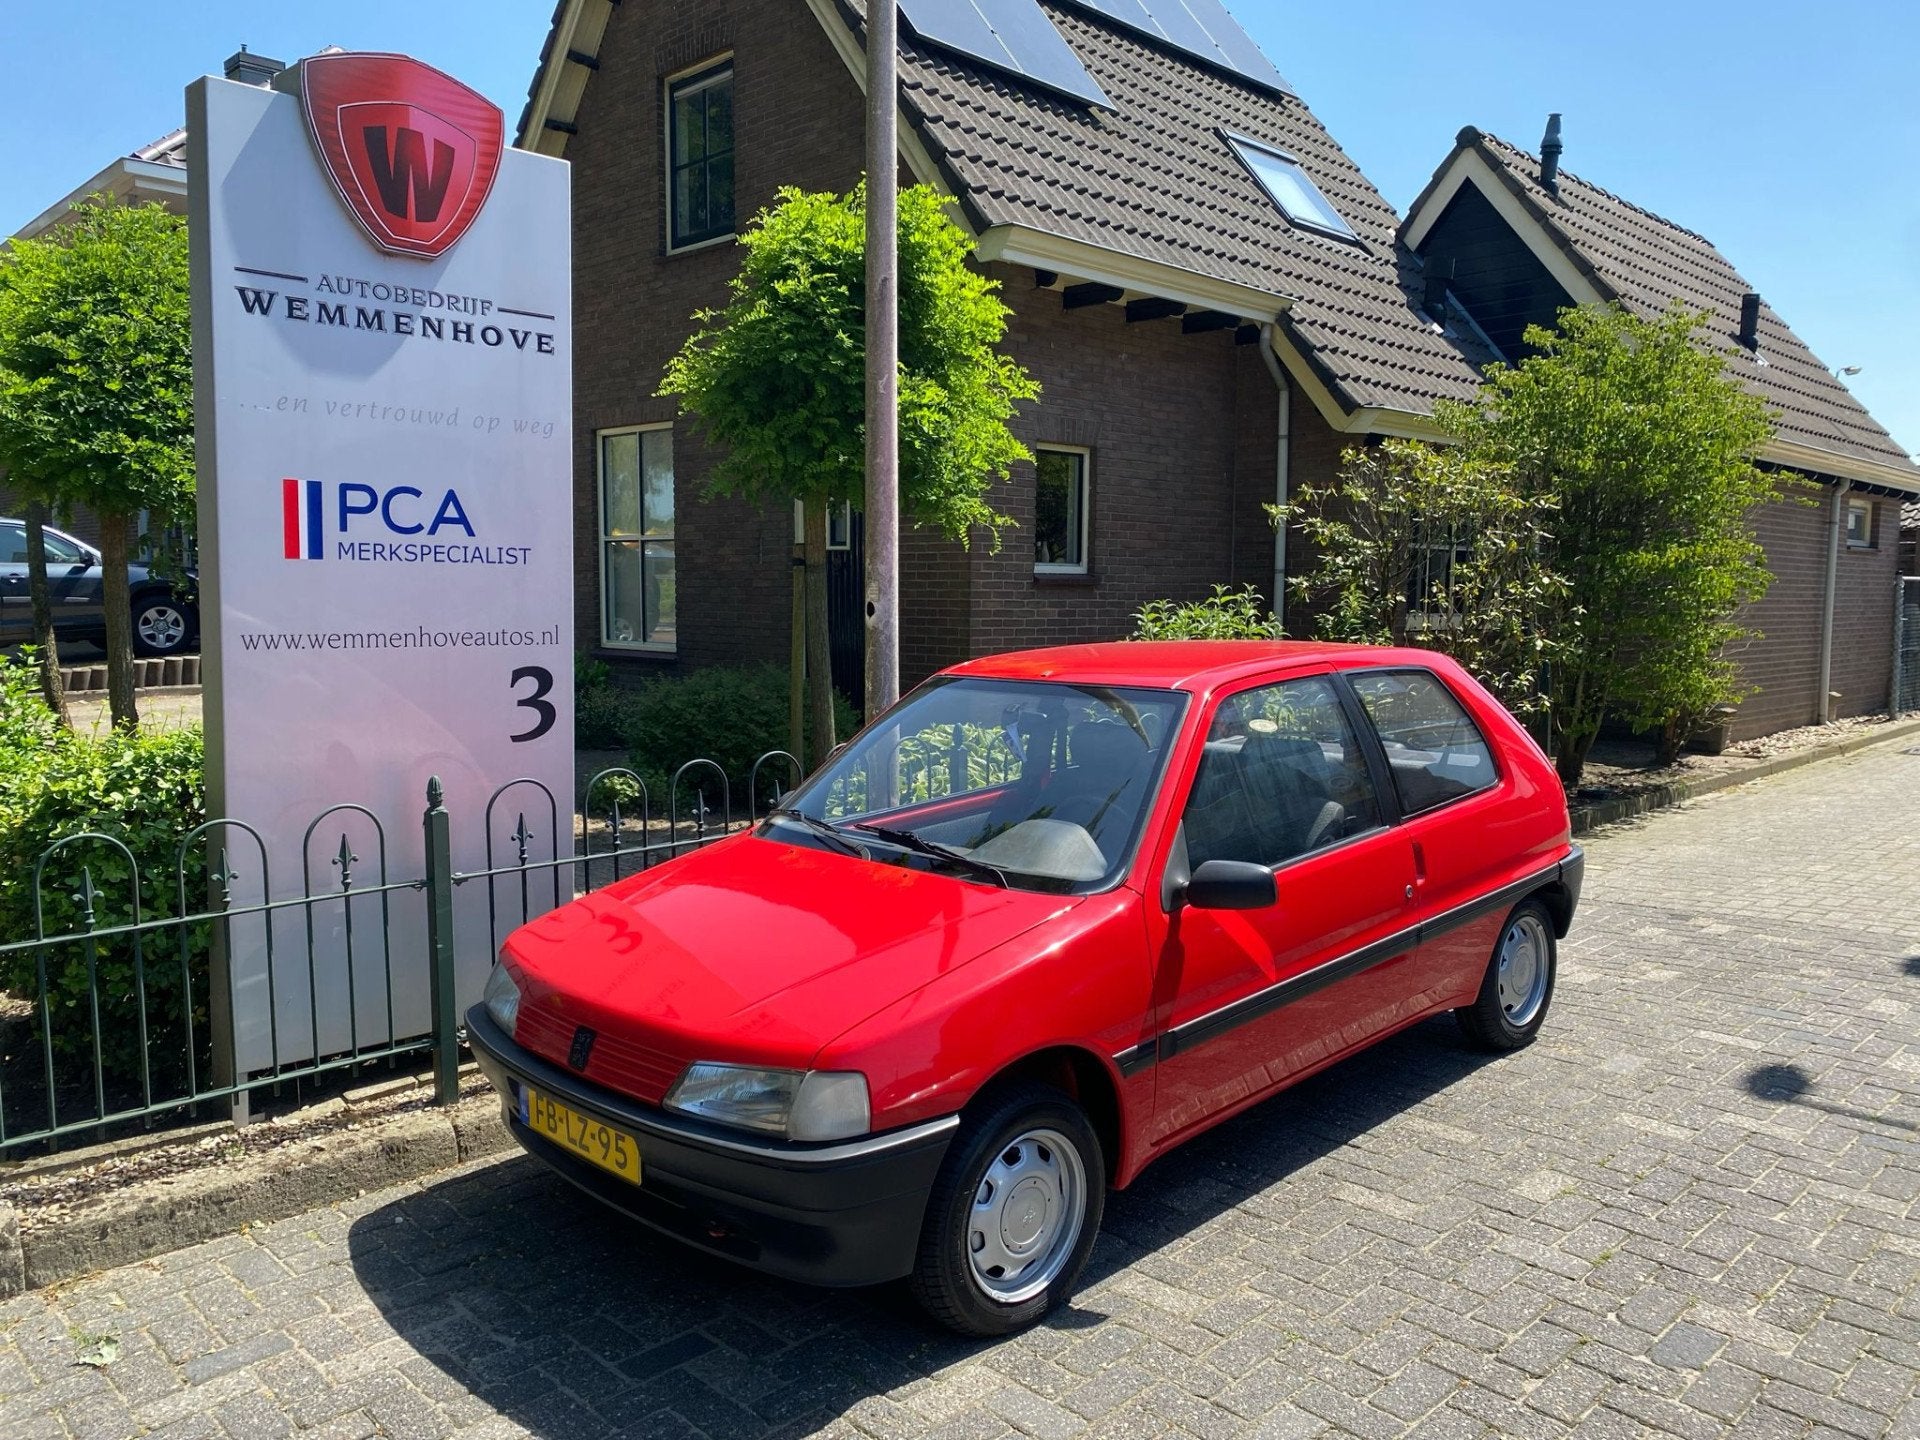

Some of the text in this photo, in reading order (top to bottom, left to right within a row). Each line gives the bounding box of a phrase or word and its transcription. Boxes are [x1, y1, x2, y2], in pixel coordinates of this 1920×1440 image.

[363, 125, 455, 222] W
[234, 286, 555, 355] WEMMENHOVE
[316, 274, 493, 317] AUTOBEDRIJF
[325, 400, 460, 428] vertrouwd
[473, 414, 501, 433] op
[513, 418, 555, 439] weg
[338, 482, 476, 537] PCA
[337, 542, 532, 565] MERKSPECIALIST
[240, 625, 560, 651] www.wemmenhoveautos.nl
[509, 666, 557, 743] 3
[535, 1092, 628, 1170] FB-LZ-95
